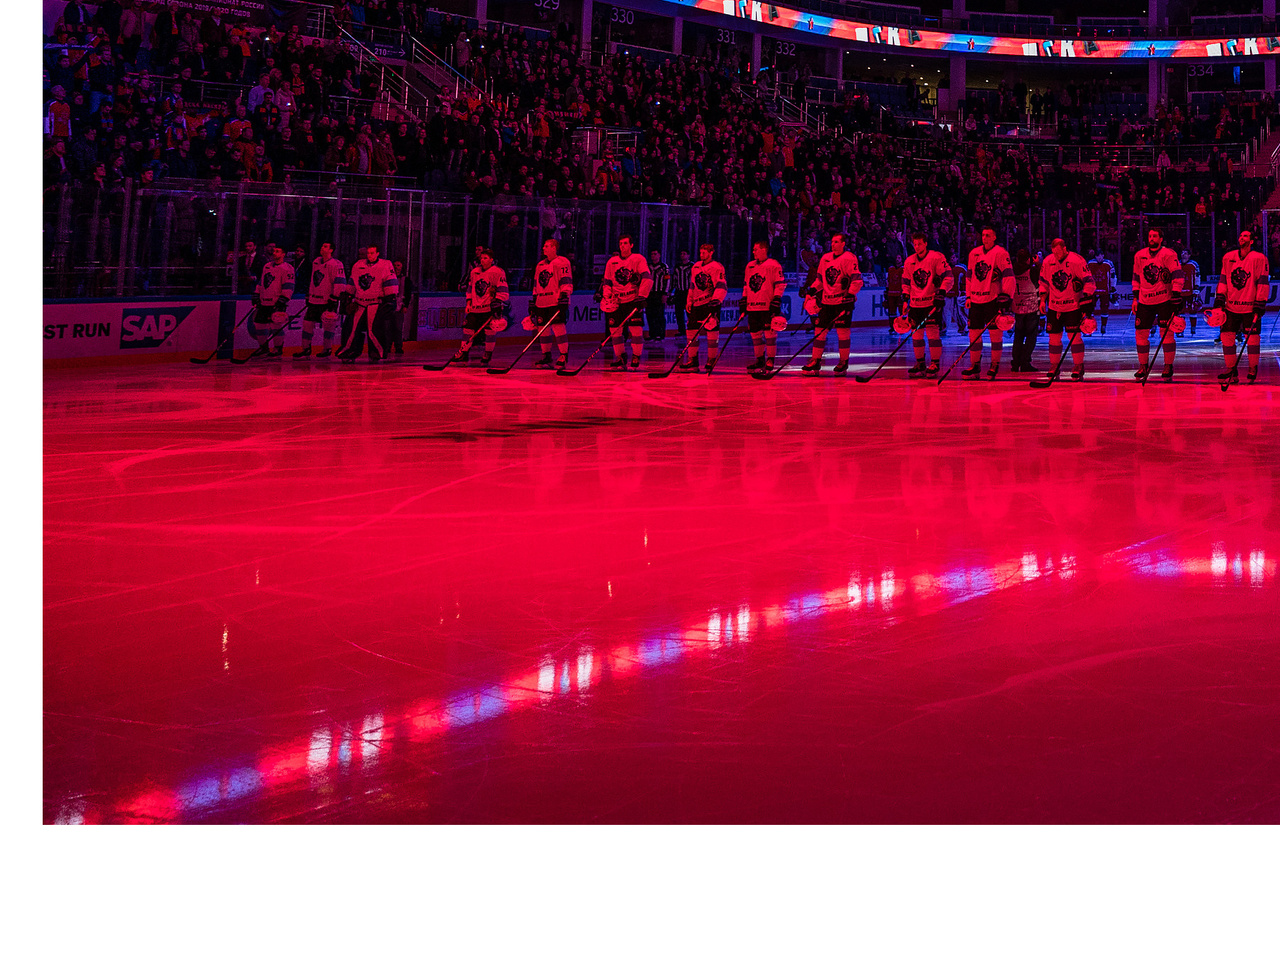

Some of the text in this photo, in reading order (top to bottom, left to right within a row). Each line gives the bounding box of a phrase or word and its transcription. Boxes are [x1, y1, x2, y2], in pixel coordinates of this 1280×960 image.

[611, 7, 634, 25] 330
[716, 28, 736, 45] 331
[374, 47, 388, 57] 210
[775, 40, 796, 56] 332
[1189, 64, 1214, 77] 334
[73, 323, 111, 339] RUN
[121, 314, 177, 342] SAP
